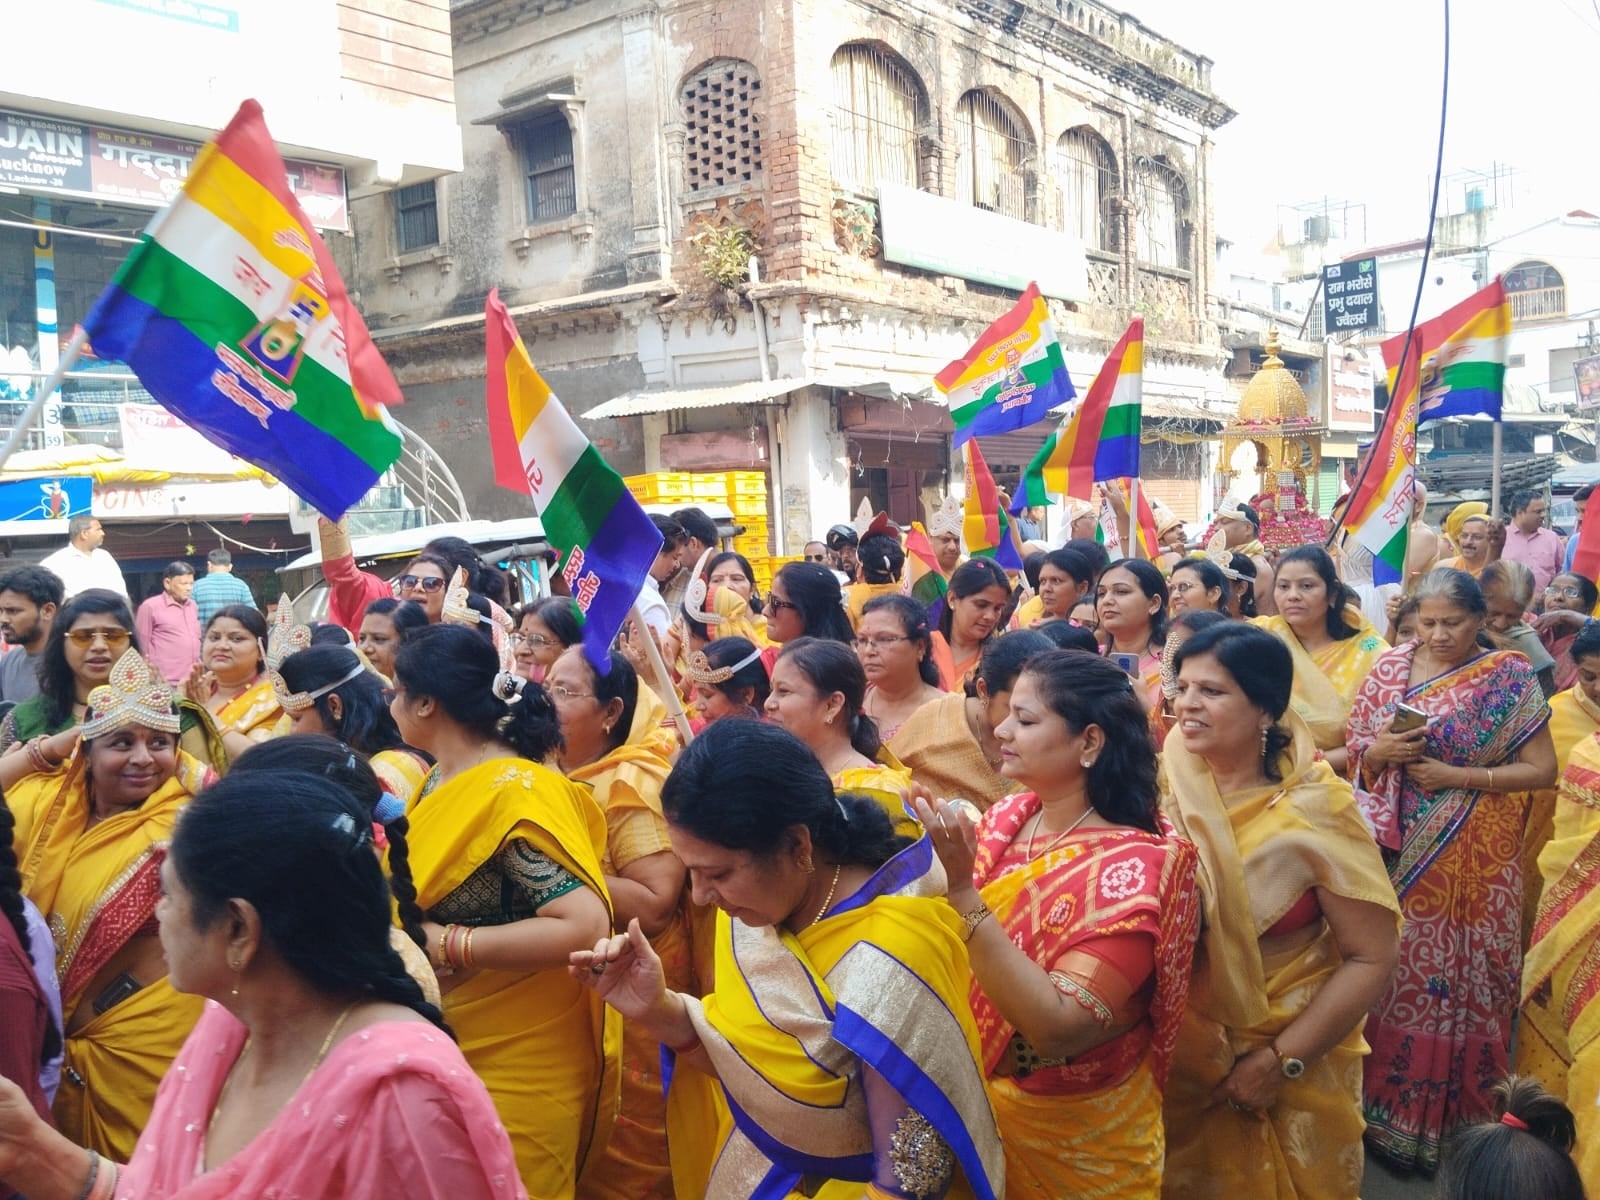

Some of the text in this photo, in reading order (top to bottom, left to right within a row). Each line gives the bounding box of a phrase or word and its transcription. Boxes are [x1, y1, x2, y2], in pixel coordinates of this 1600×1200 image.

[0, 125, 83, 158] JAIN
[0, 158, 67, 177] ucknow
[1327, 273, 1373, 295] राम भरोसे
[1328, 292, 1374, 313] प्रभु दयाल
